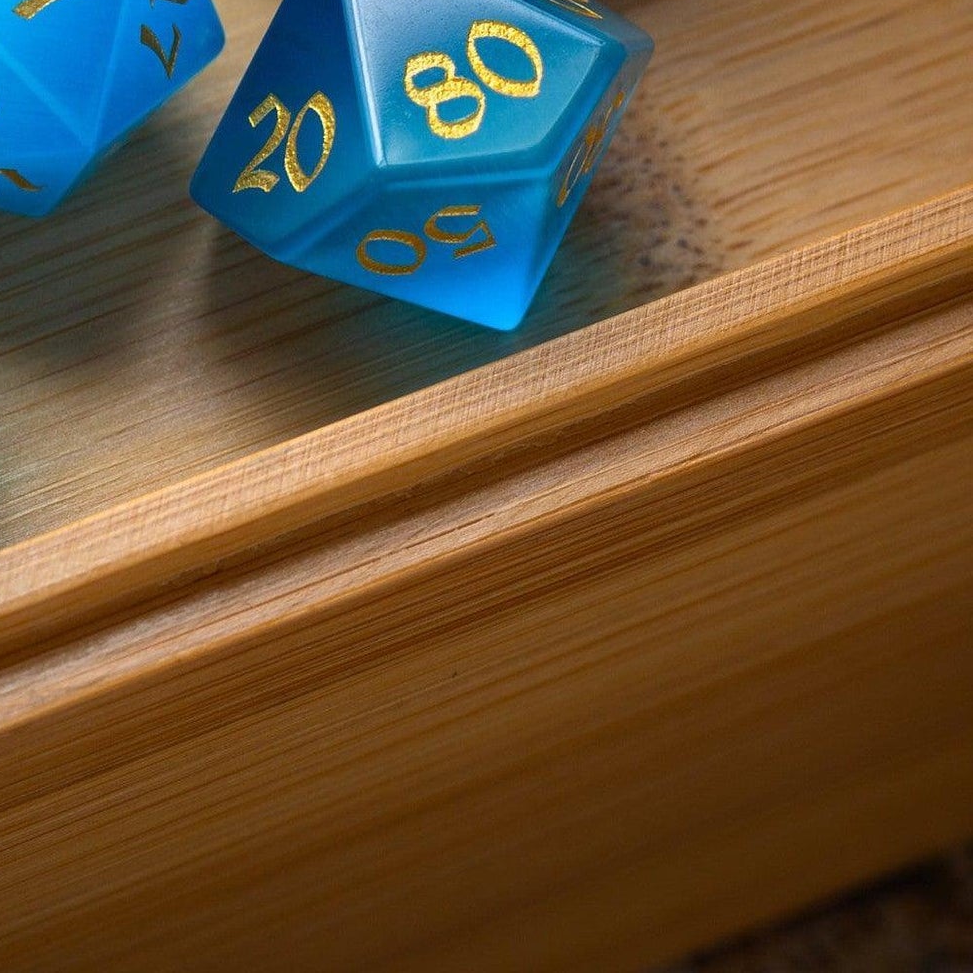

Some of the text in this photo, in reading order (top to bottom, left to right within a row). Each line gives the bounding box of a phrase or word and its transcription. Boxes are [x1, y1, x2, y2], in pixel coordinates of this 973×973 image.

[404, 19, 544, 140] 80
[232, 91, 336, 193] 20
[356, 205, 496, 276] 50
